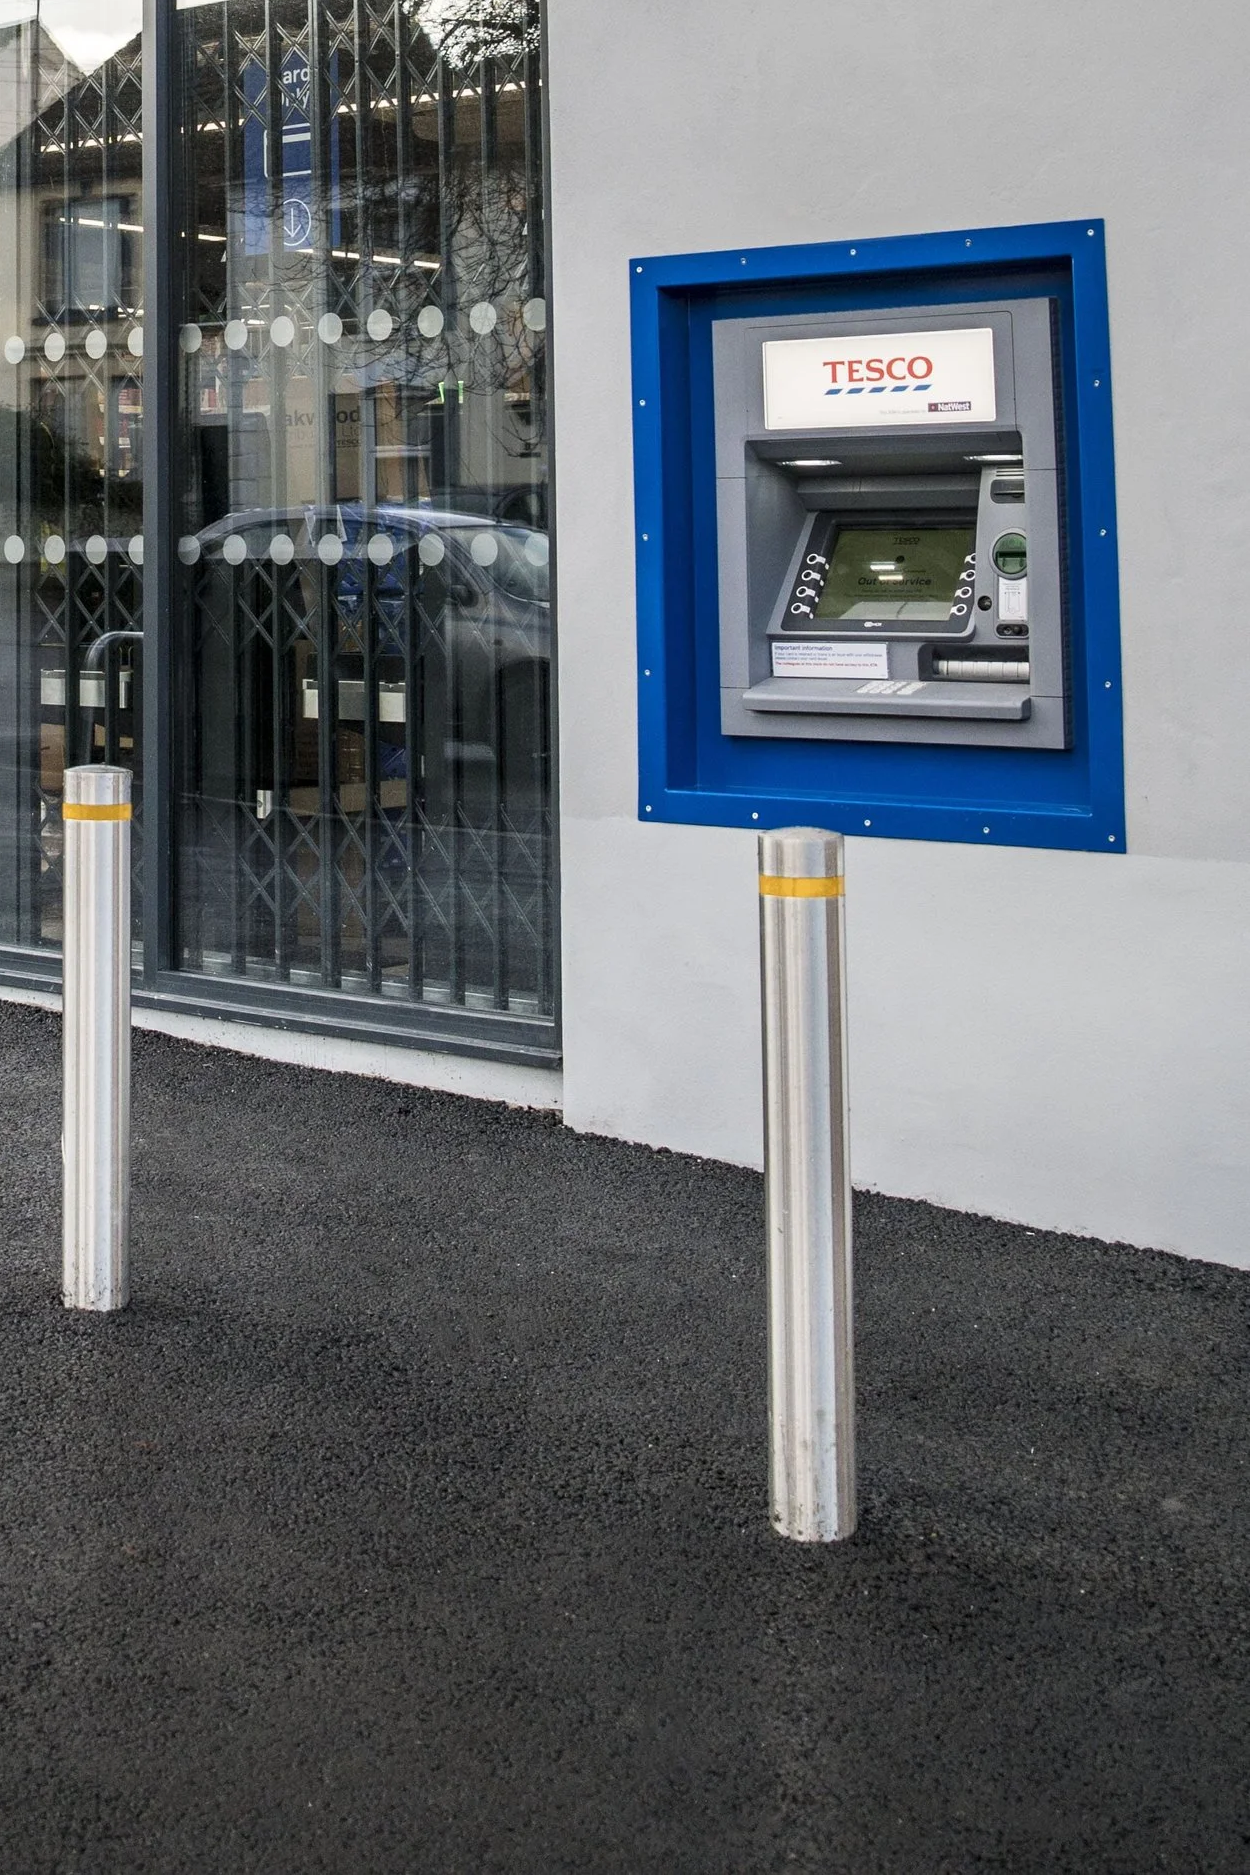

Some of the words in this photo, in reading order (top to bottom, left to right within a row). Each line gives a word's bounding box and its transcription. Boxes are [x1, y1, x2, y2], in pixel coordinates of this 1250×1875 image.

[282, 66, 310, 84] ard
[822, 355, 933, 384] TESCO
[937, 401, 970, 412] NatWest
[857, 576, 877, 586] Out
